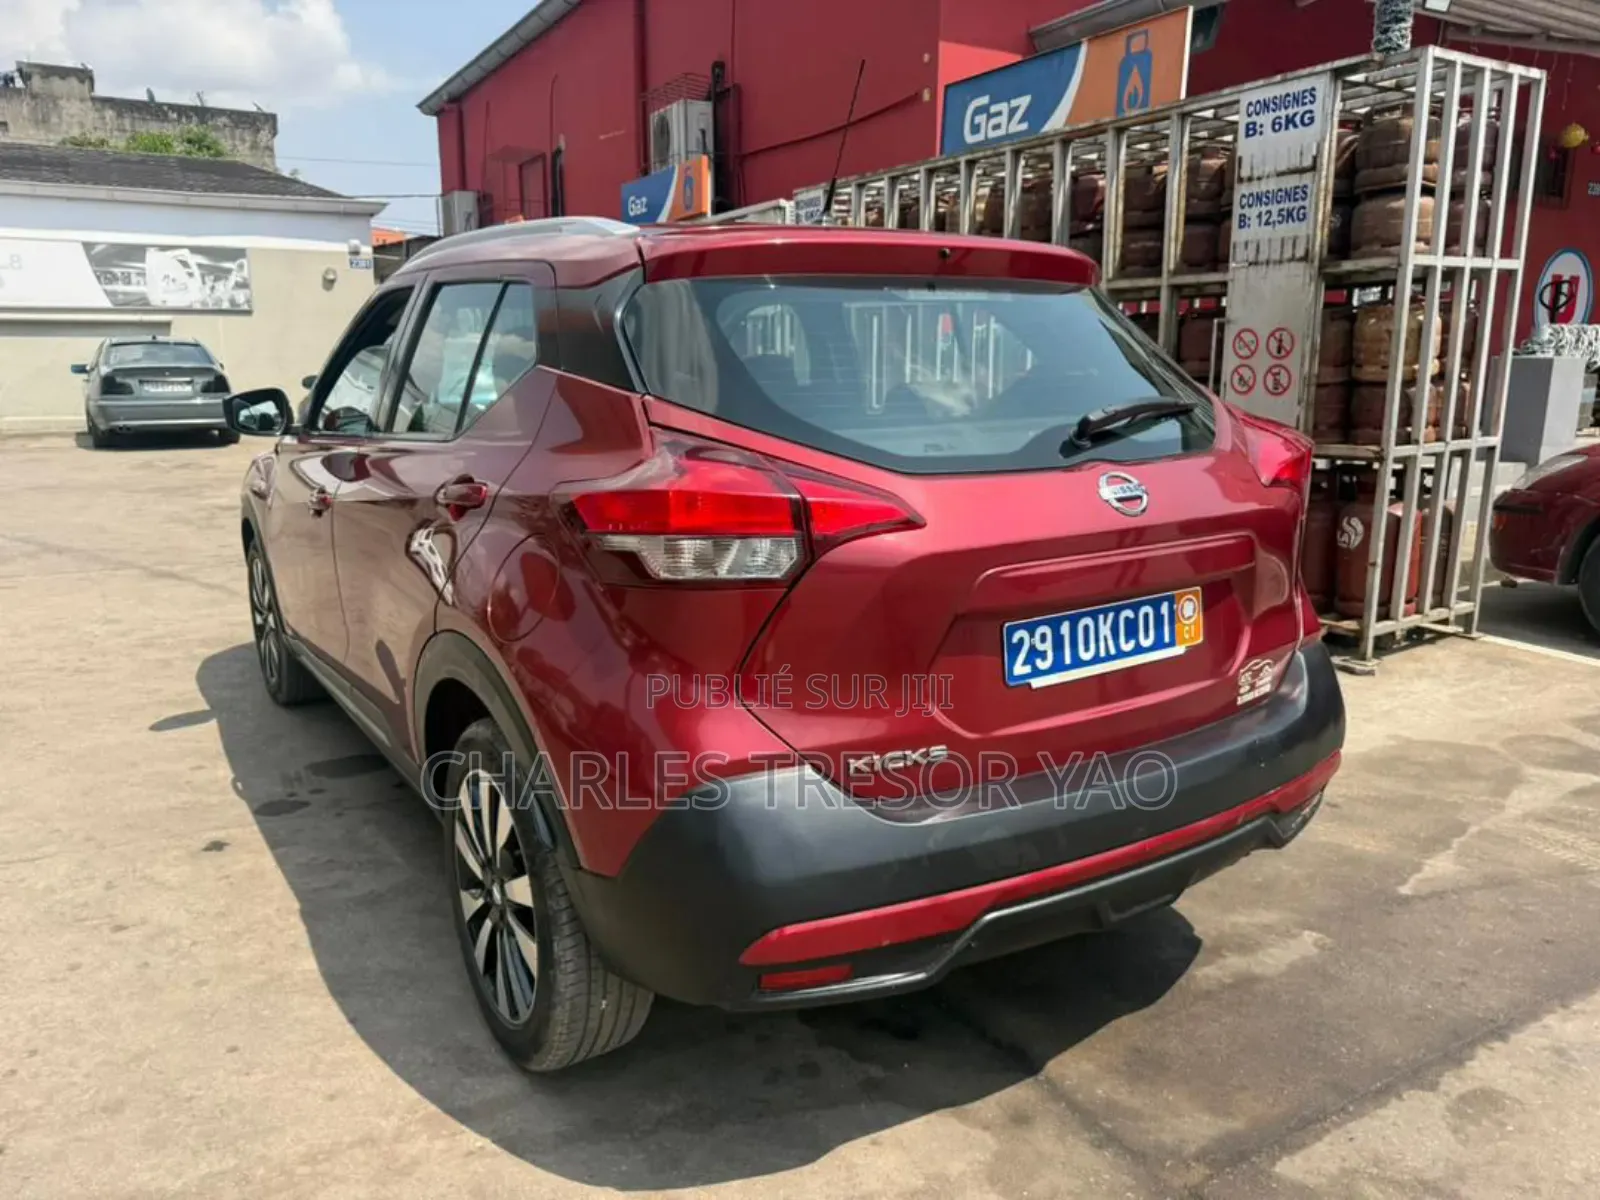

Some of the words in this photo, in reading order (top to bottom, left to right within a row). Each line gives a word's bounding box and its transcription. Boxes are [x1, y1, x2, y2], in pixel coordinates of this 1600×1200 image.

[1246, 87, 1317, 118] CONSIGNES
[964, 94, 1031, 144] Gaz
[1244, 121, 1264, 139] B:
[1271, 109, 1315, 133] 6KG
[628, 195, 648, 217] Gaz
[1240, 184, 1309, 210] CONSIGNES
[1238, 213, 1251, 230] B:
[1256, 205, 1307, 229] 12,5KG
[1012, 601, 1170, 676] 2910KC01
[848, 744, 948, 775] KICKS
